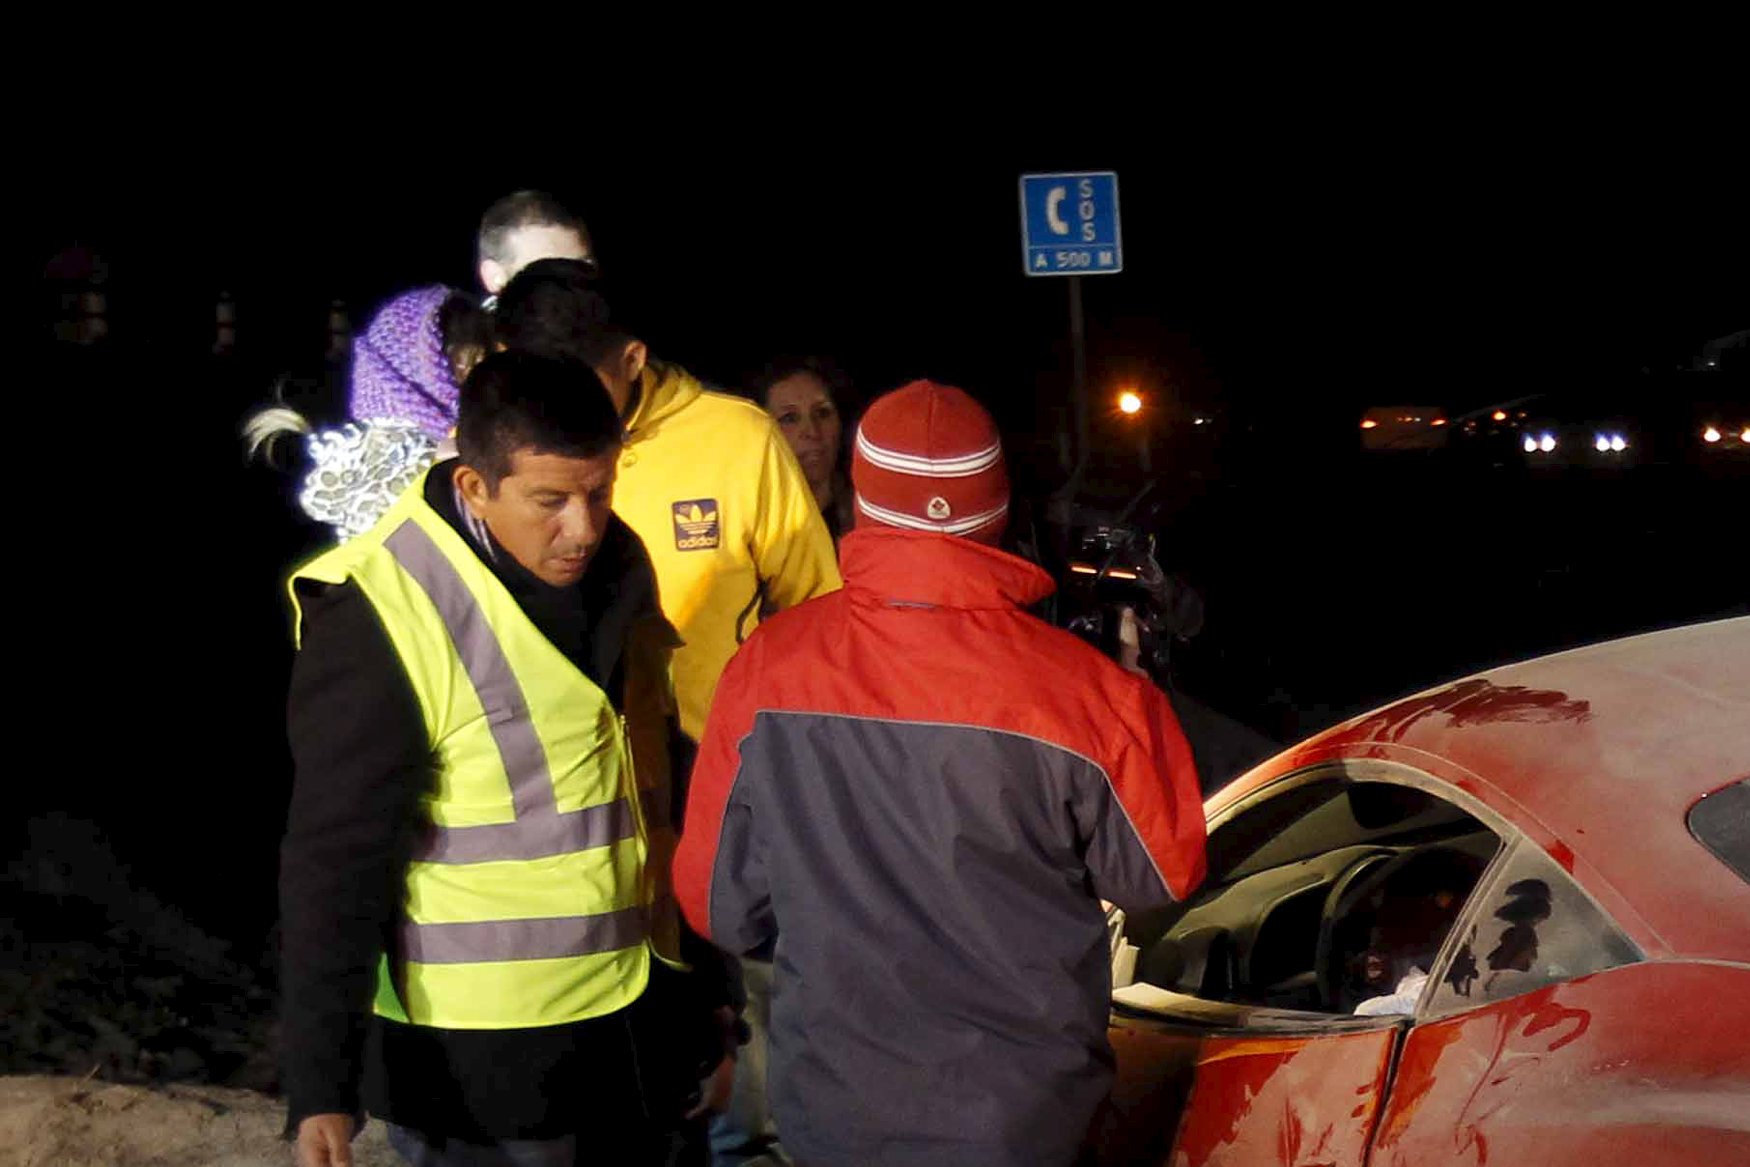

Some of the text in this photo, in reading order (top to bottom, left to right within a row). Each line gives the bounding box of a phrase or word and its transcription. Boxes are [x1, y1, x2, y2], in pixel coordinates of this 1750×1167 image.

[1080, 179, 1095, 241] SOS
[1035, 253, 1048, 268] A
[1056, 252, 1090, 267] 500
